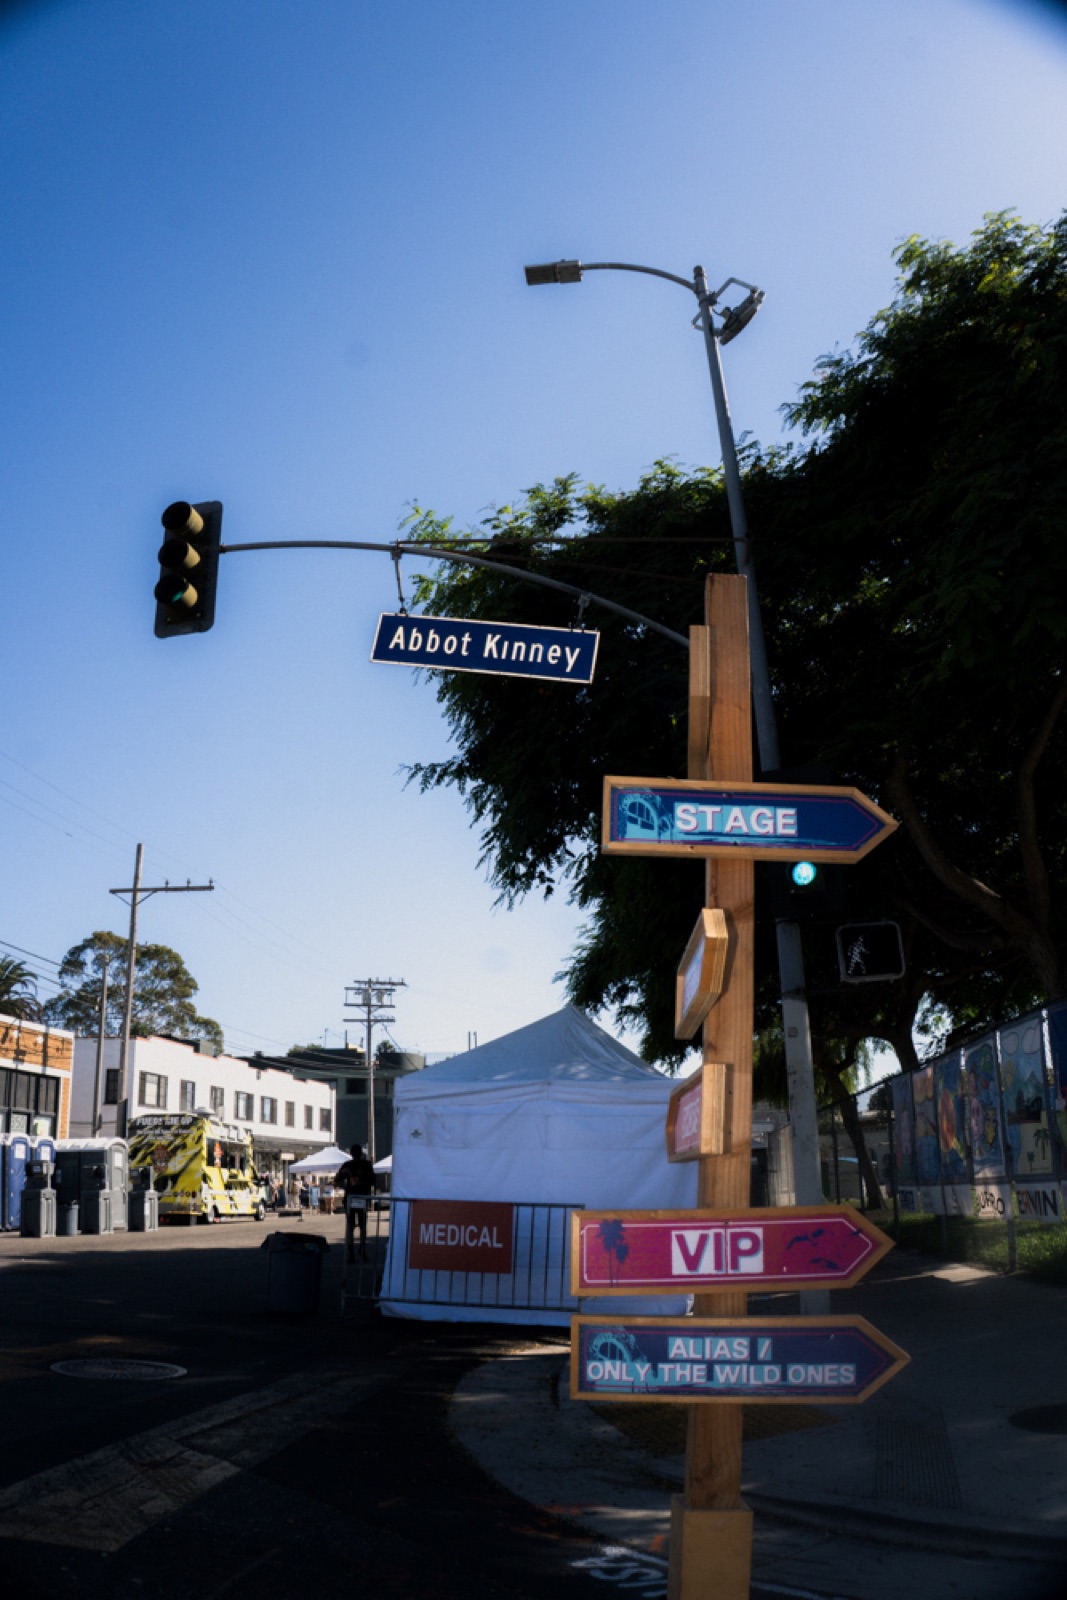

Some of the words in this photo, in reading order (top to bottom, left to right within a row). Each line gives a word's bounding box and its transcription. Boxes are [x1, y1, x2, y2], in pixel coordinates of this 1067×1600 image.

[389, 626, 472, 656] Abbot
[483, 633, 581, 672] Kinney
[675, 804, 798, 835] STAGE
[419, 1223, 503, 1248] MEDICAL
[674, 1230, 762, 1272] VIP
[669, 1338, 749, 1359] ALIAS
[759, 1338, 772, 1360] /
[587, 1362, 651, 1382] ONLY
[659, 1363, 707, 1383] THE
[714, 1364, 781, 1384] WILD
[788, 1365, 856, 1385] ONES
